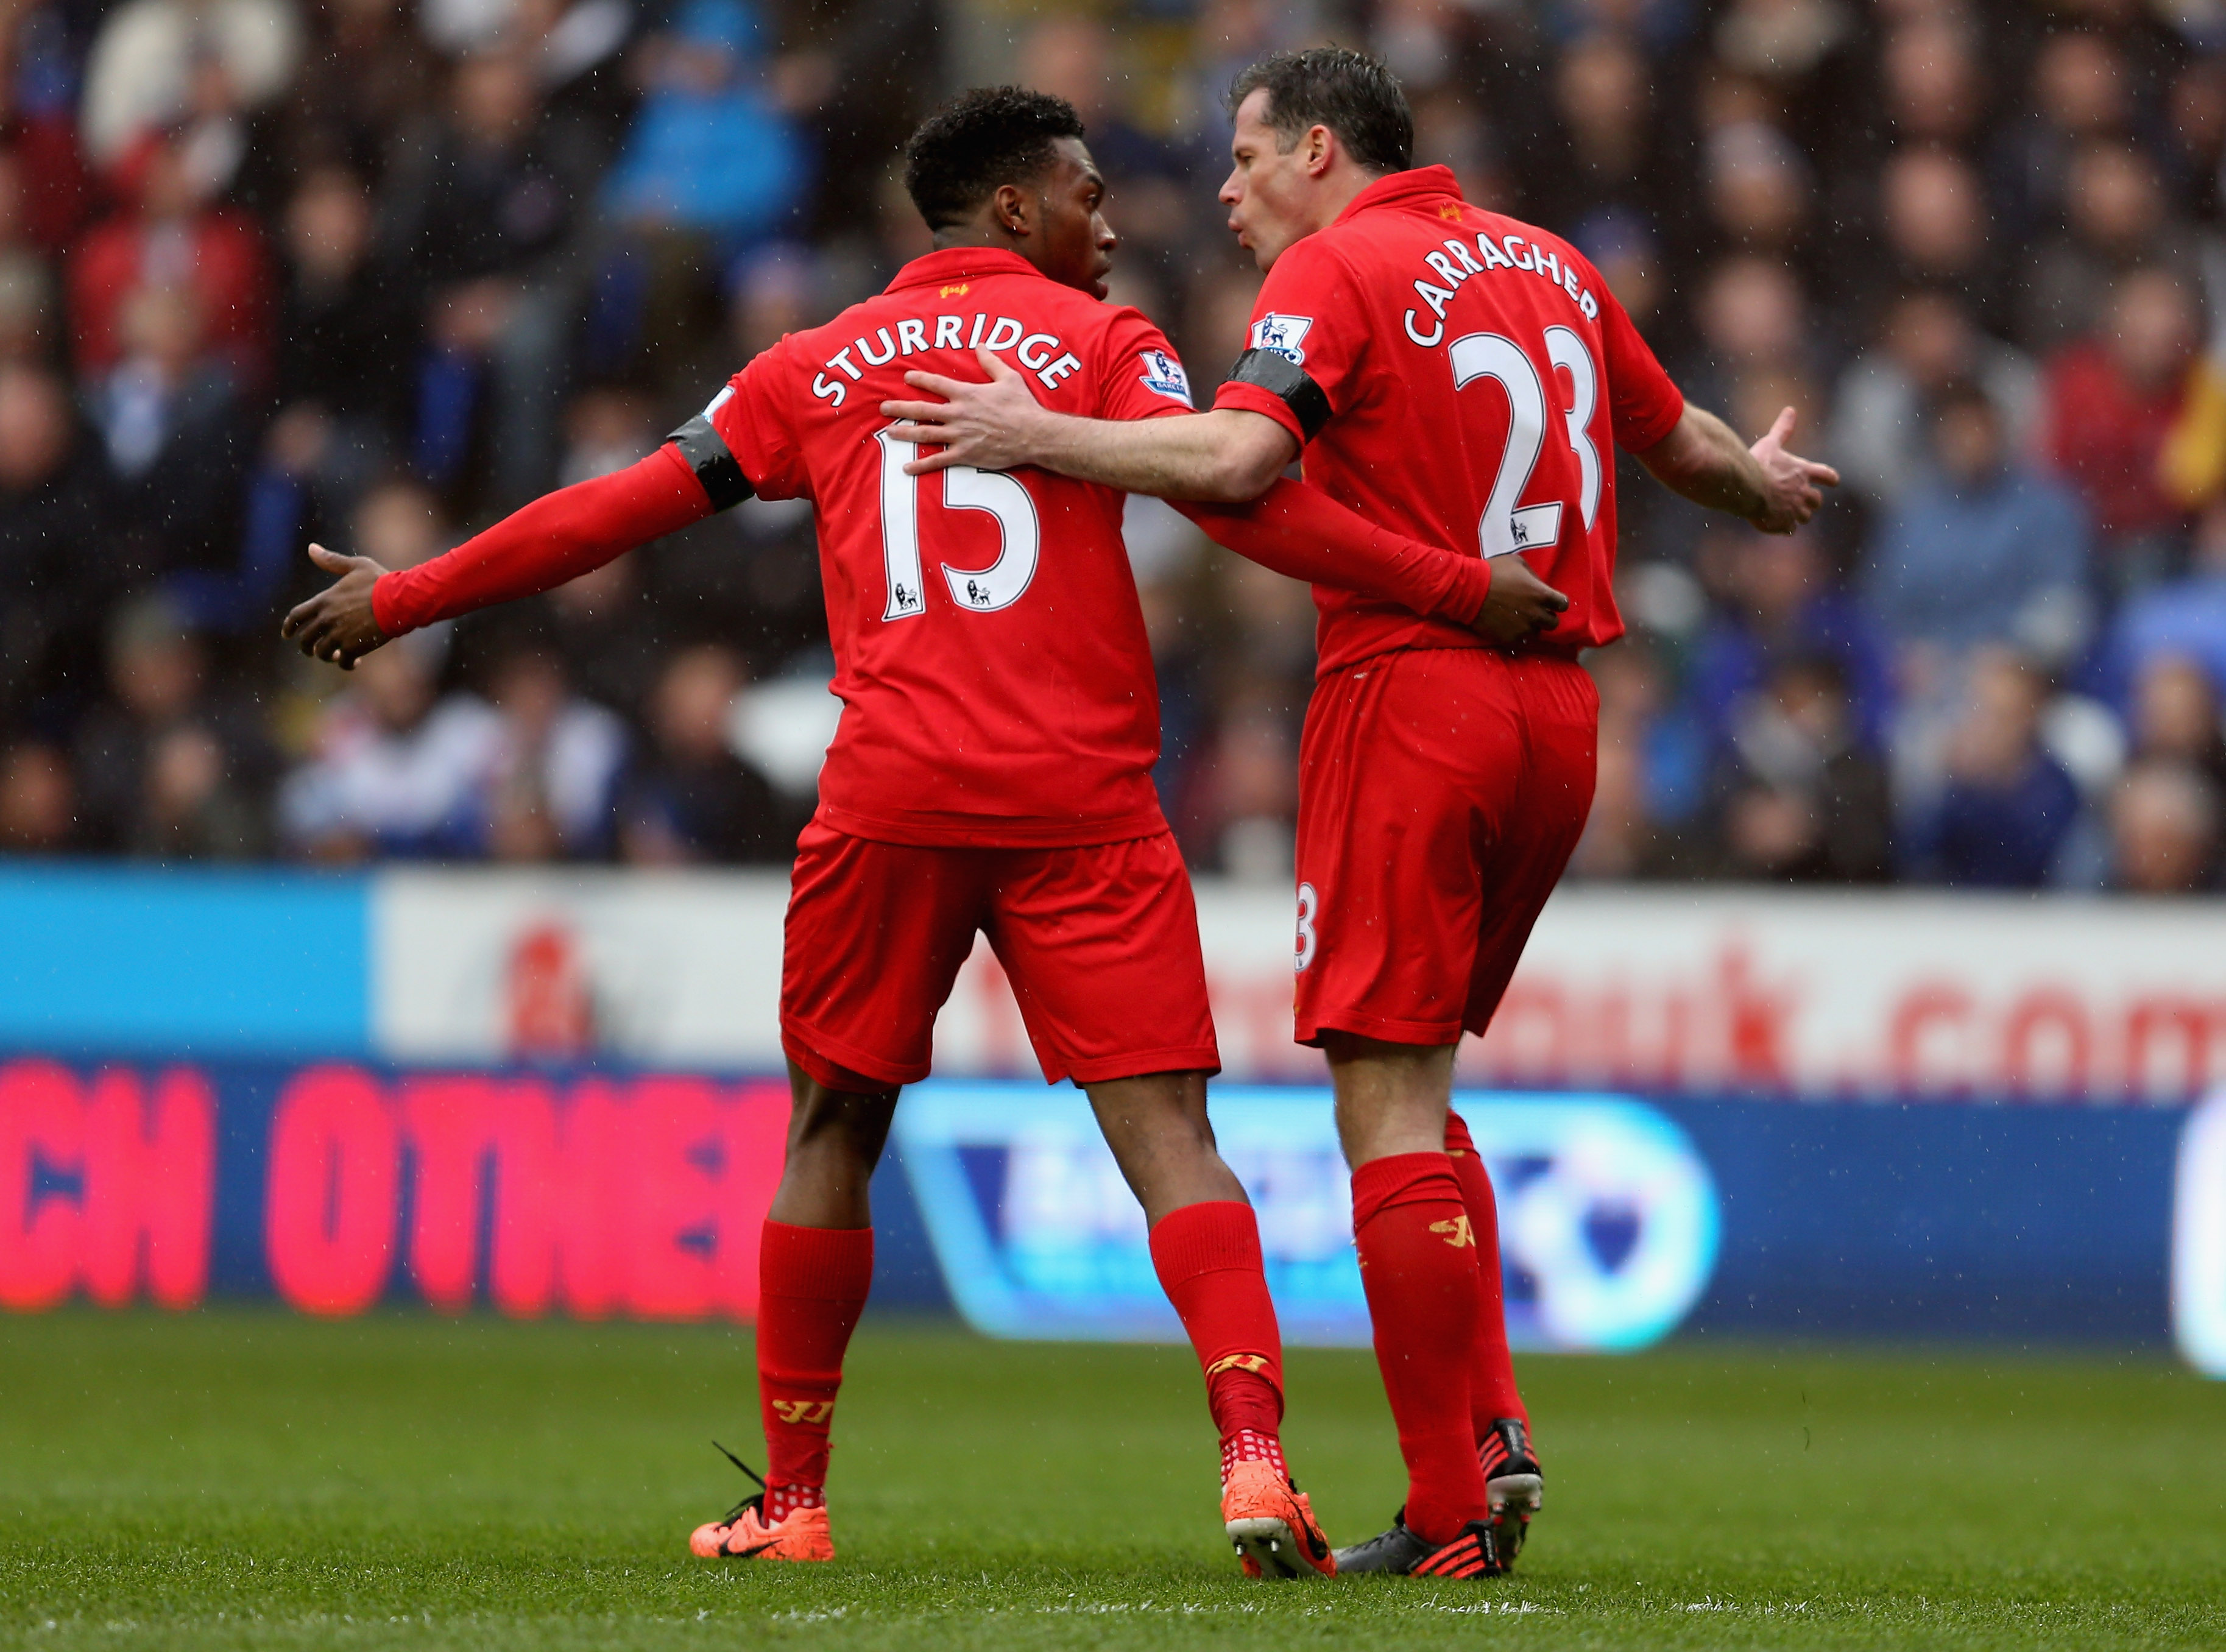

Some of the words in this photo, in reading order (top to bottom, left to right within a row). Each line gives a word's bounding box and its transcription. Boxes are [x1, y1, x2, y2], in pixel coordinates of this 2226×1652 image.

[811, 312, 1083, 408] STURRIDGE
[1403, 232, 1600, 348] CARRAGHER
[873, 417, 1041, 623] 15
[1447, 323, 1602, 559] 23
